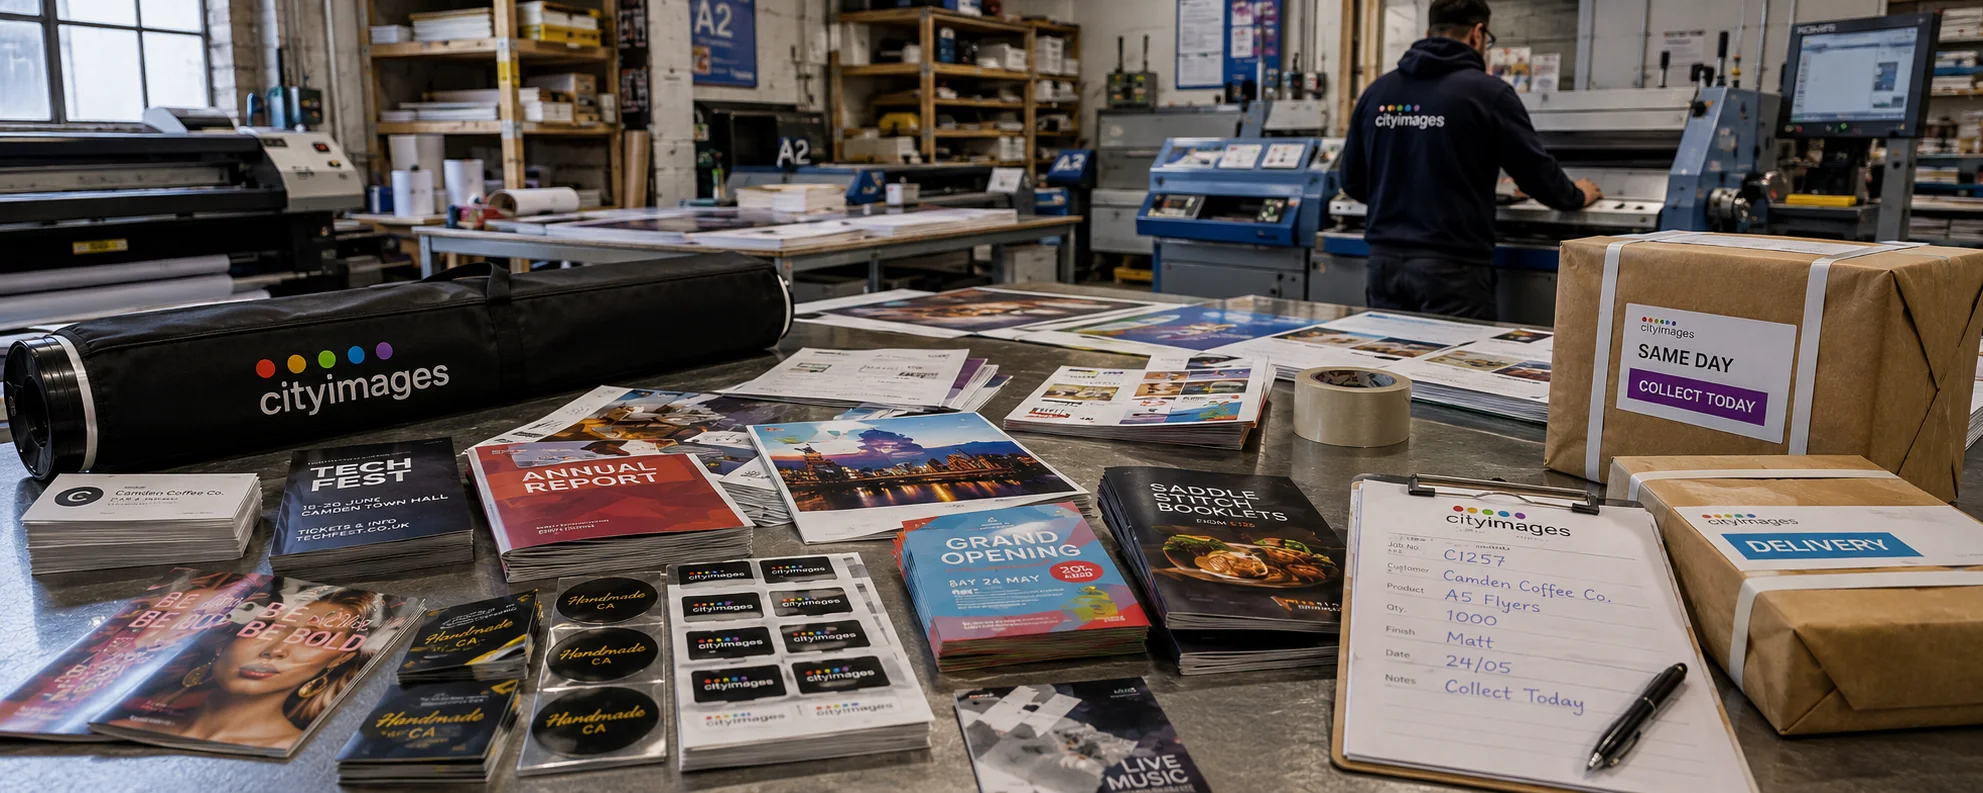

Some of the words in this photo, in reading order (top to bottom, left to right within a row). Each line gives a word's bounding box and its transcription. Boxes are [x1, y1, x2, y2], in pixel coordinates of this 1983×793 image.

[694, 0, 734, 38] A2
[1375, 112, 1445, 129] cityimages
[776, 137, 811, 167] A2
[1640, 323, 1694, 339] cityimages
[1638, 343, 1690, 366] SAME
[1695, 352, 1734, 373] DAY
[260, 364, 450, 416] cityimages
[1639, 380, 1702, 403] COLLECT
[1706, 392, 1756, 413] TODAY
[310, 457, 412, 478] TECH
[522, 461, 657, 482] ANNUAL
[311, 469, 412, 492] FEST
[524, 472, 657, 494] REPORT
[1150, 482, 1260, 500] SADDLE
[301, 505, 361, 517] CAMDEN
[365, 499, 407, 510] TOWN
[411, 494, 449, 504] HALL
[1153, 492, 1253, 509] STITCH
[1157, 502, 1288, 522] BOOKLETS
[298, 524, 351, 535] TICKETS
[1446, 513, 1571, 537] cityimages
[1708, 517, 1799, 528] cityimages
[945, 531, 1059, 550] GRAND
[1745, 538, 1889, 553] DELIVERY
[940, 544, 1081, 565] OPENING
[1444, 549, 1505, 567] C1257
[688, 571, 745, 581] cityimages
[1006, 575, 1040, 584] MAY
[1386, 582, 1425, 594] Product
[1443, 569, 1511, 590] Camden
[1519, 580, 1575, 598] Coffee
[1583, 588, 1612, 603] Co.
[567, 589, 646, 606] Handmade
[596, 602, 615, 610] CA
[1444, 589, 1473, 603] A5
[1483, 594, 1541, 614] Flyers
[257, 602, 309, 622] BE
[692, 603, 754, 614] cityimages
[1446, 610, 1498, 626] 1000
[236, 621, 287, 640] BE
[283, 628, 367, 651] BOLD
[424, 618, 514, 645] Handmade
[793, 632, 857, 644] cityimages
[1385, 625, 1416, 636] Finish
[698, 638, 764, 651] cityimages
[1446, 631, 1495, 649] Matt
[559, 642, 647, 660] Handmade
[1385, 649, 1411, 659] Date
[591, 657, 612, 665] CA
[1446, 654, 1513, 674] 24/05
[806, 668, 875, 684] cityimages
[1384, 673, 1417, 685] Notes
[704, 678, 774, 693] cityimages
[1444, 679, 1513, 700] Collect
[1523, 687, 1585, 716] Today
[375, 707, 485, 728] Handmade
[546, 705, 646, 728] Handmade
[408, 726, 436, 740] CA
[582, 724, 606, 735] CA
[1119, 754, 1182, 774] LIVE
[1106, 768, 1189, 791] MUSIC
